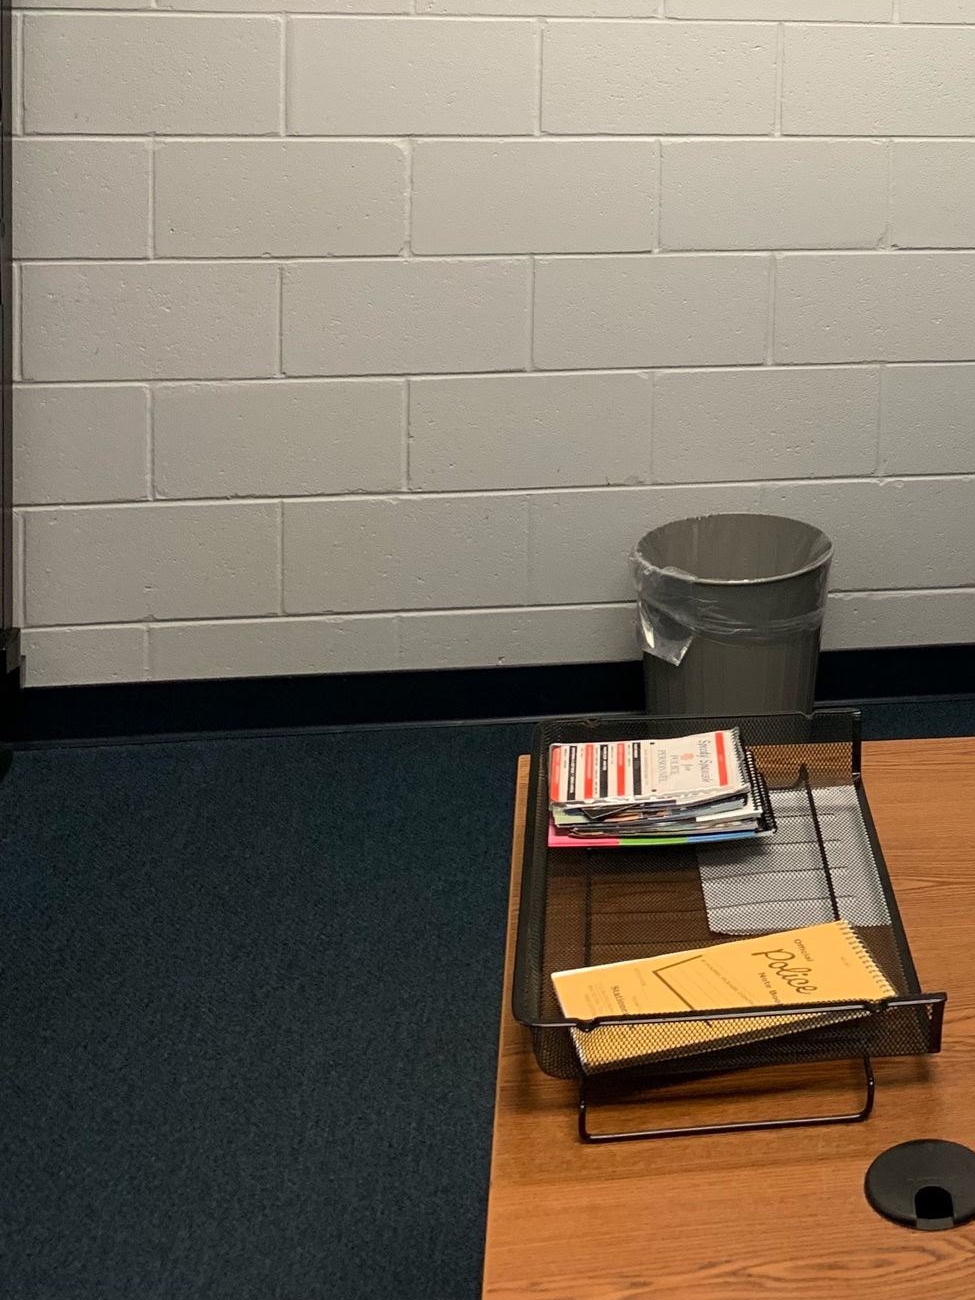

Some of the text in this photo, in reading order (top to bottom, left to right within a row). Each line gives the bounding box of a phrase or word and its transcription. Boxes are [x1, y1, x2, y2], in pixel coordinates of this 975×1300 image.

[698, 760, 713, 783] Spanish
[794, 938, 814, 962] Official
[751, 948, 818, 995] Police
[758, 971, 781, 1004] Note Boo
